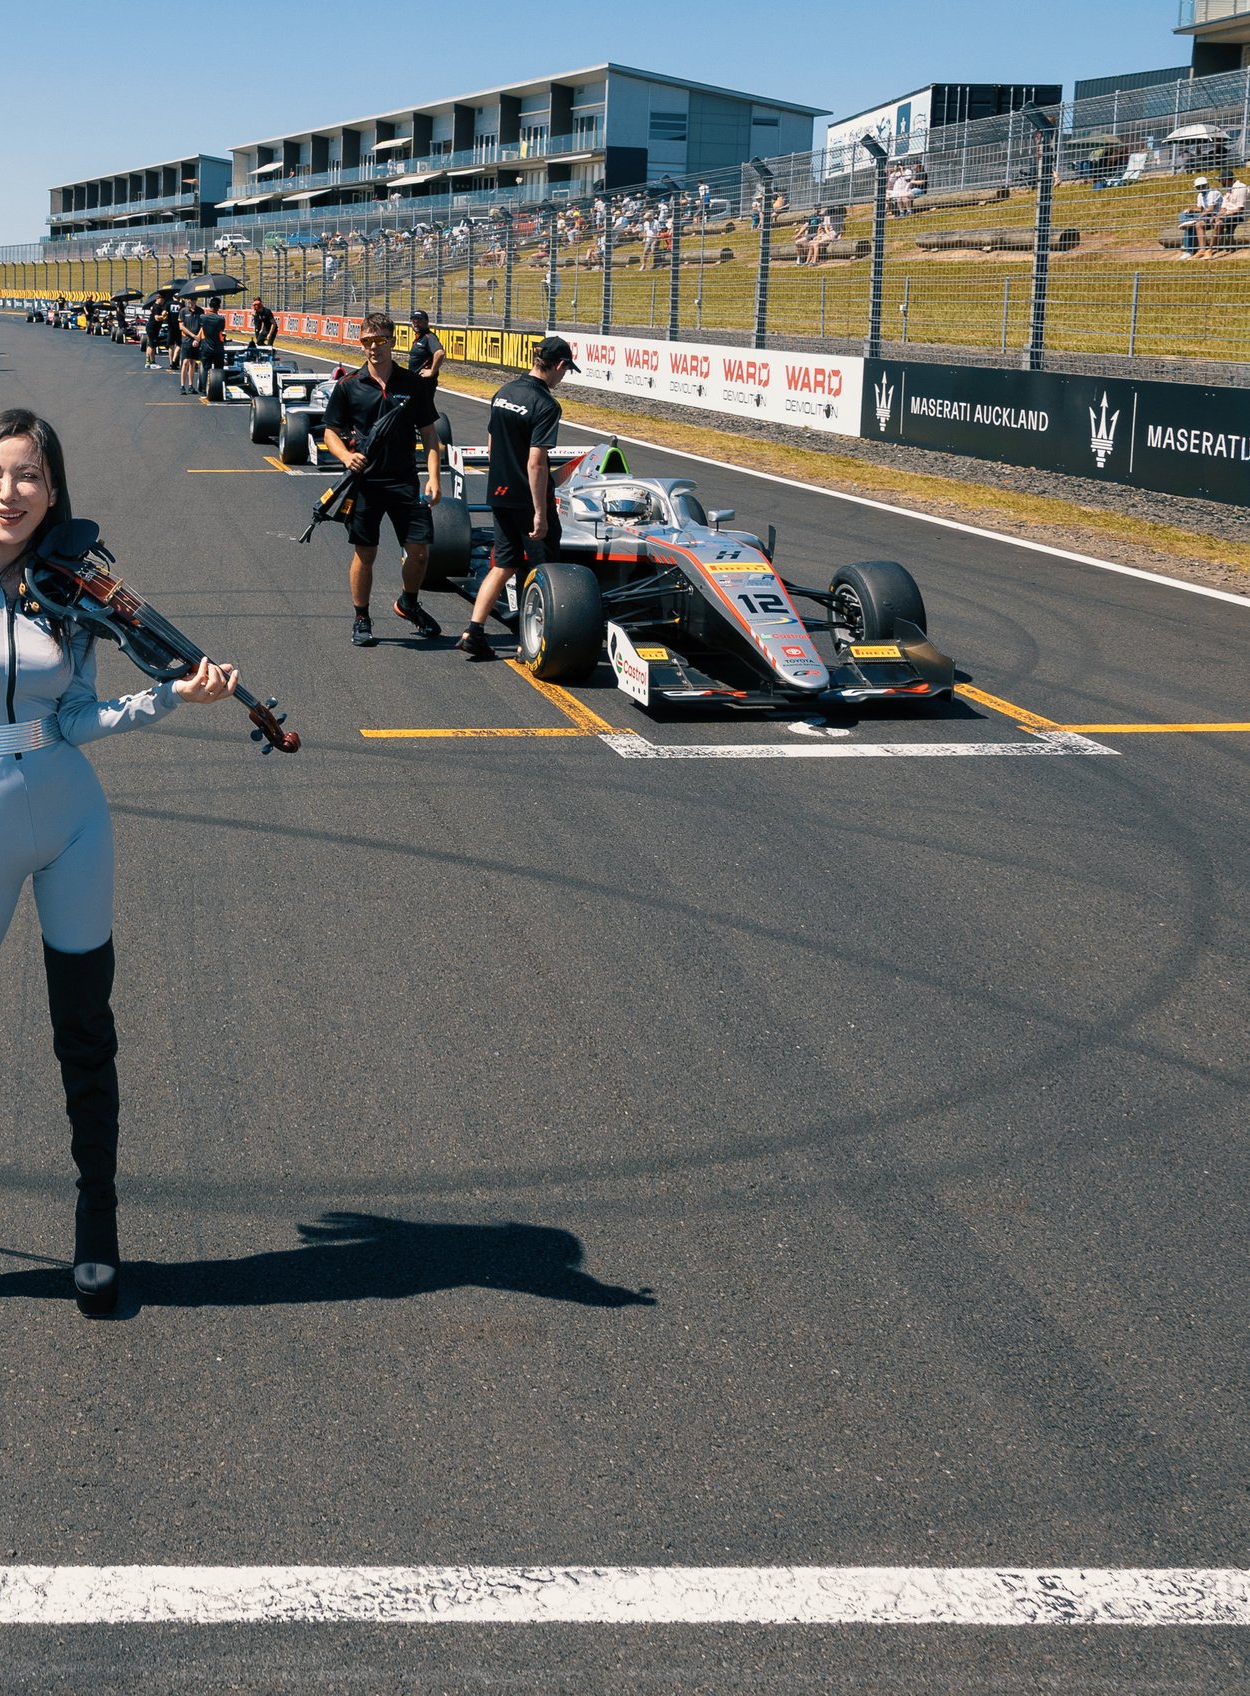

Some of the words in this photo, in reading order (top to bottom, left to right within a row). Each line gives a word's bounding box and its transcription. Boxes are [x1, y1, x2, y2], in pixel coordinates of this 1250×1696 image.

[503, 332, 528, 369] DAYLE
[910, 396, 961, 422] MASERATI
[973, 404, 1049, 432] AUCKLAND
[737, 594, 790, 613] 12
[854, 648, 897, 656] PIRELLI
[623, 660, 648, 687] Castrol
